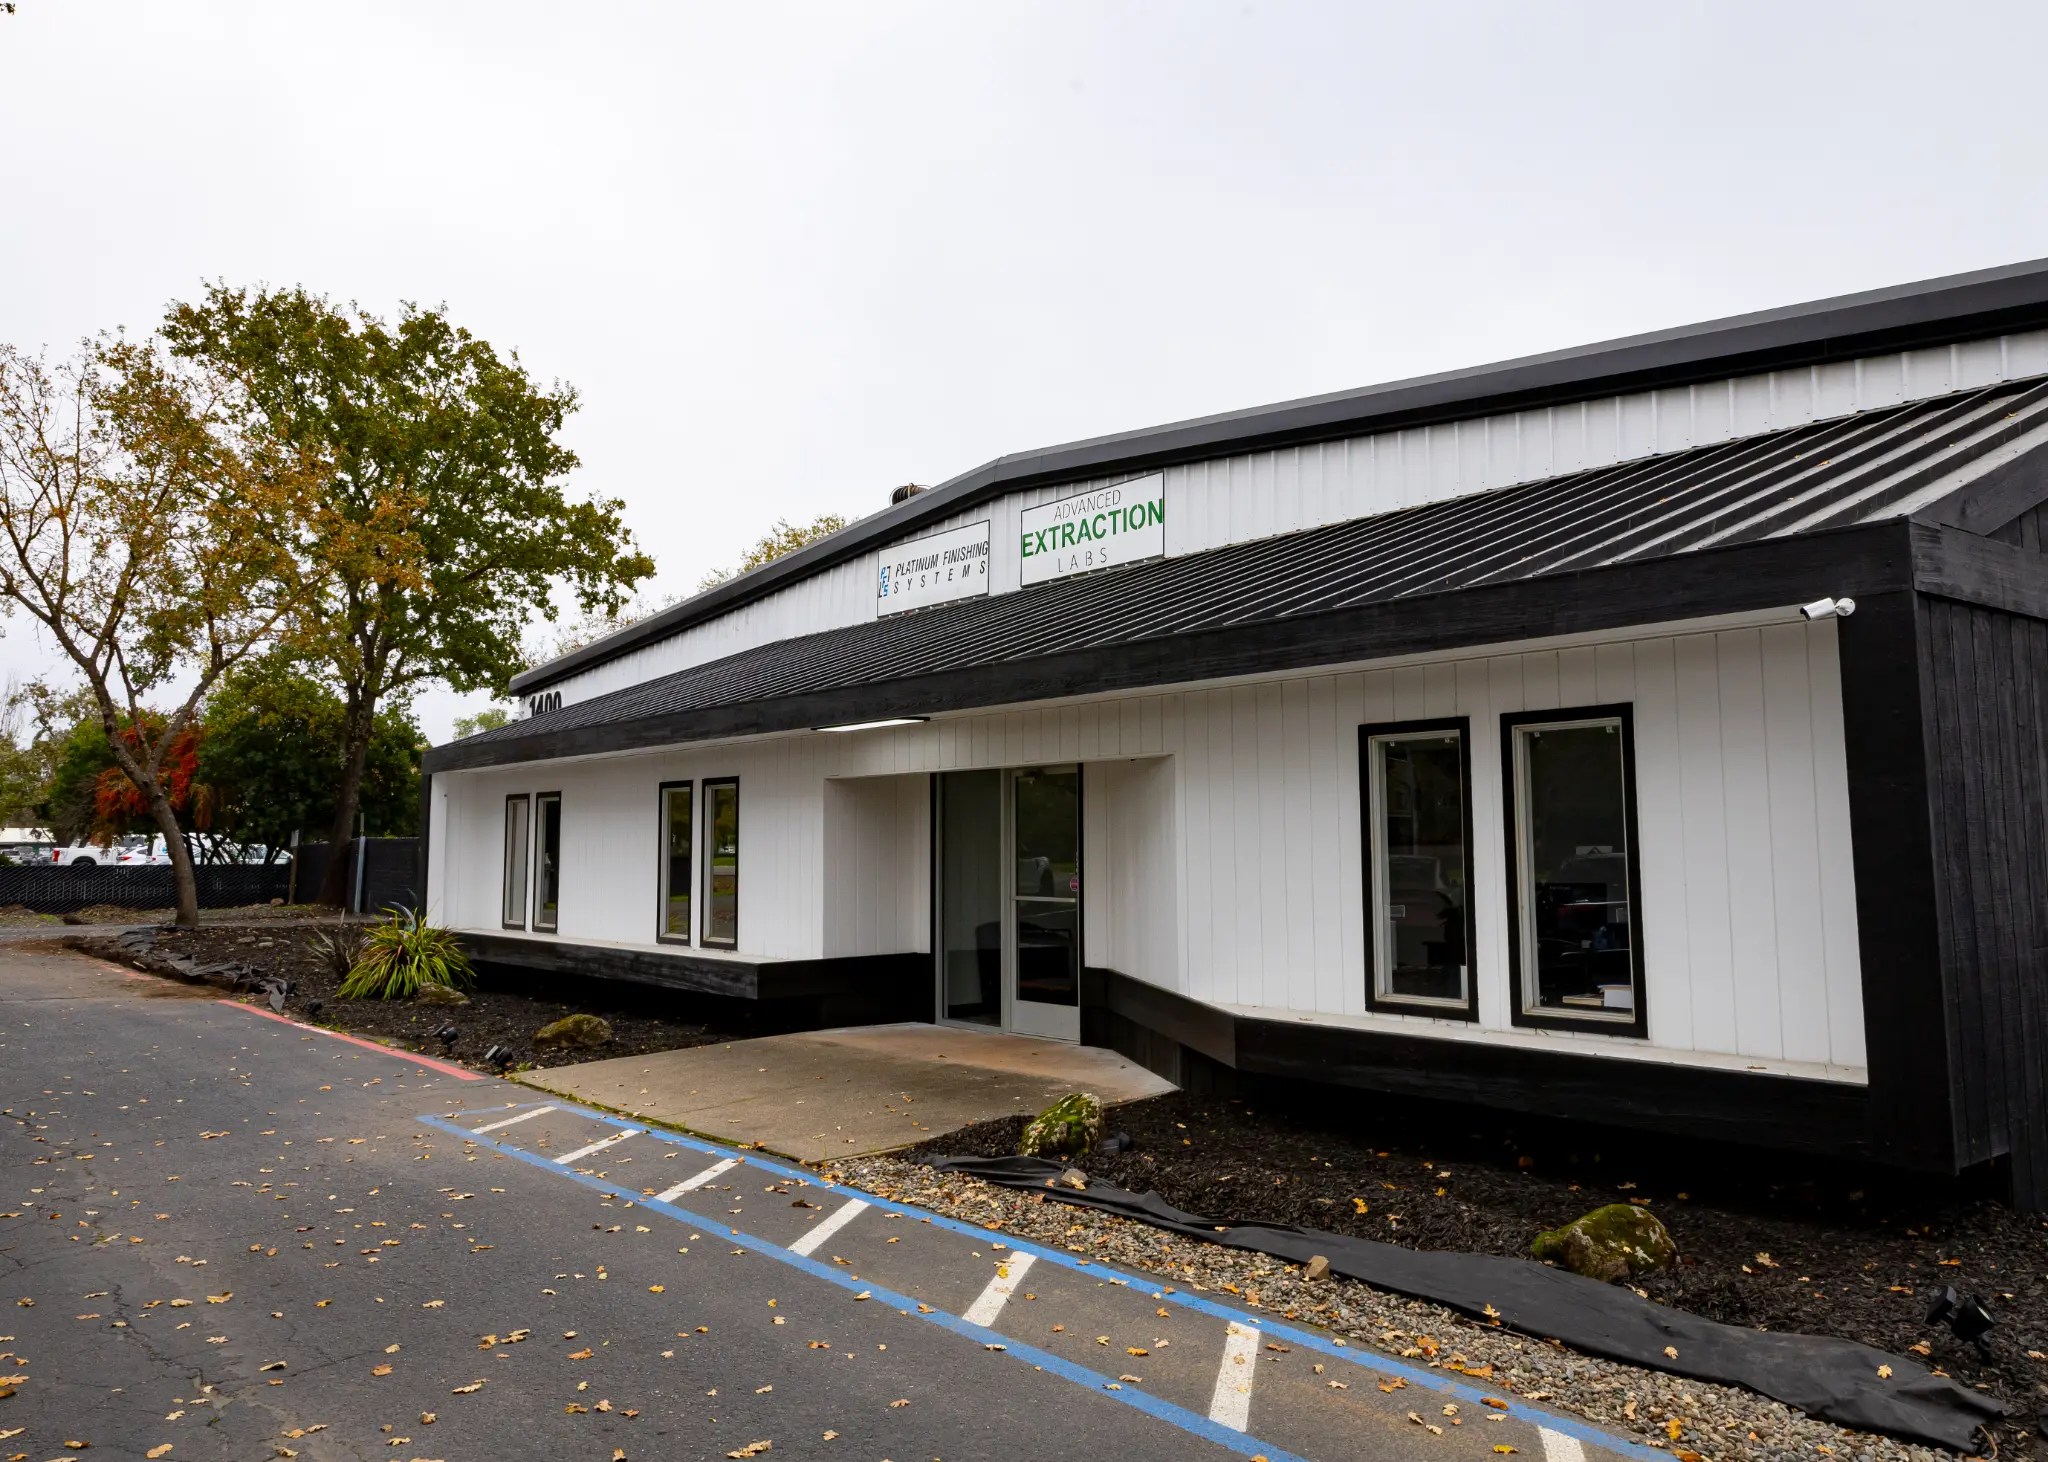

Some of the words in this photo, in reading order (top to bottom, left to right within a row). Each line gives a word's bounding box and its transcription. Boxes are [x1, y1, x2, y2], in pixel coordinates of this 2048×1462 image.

[1053, 489, 1121, 522] ADVANCED
[1022, 498, 1163, 558] EXTRACTION
[895, 553, 939, 578] PLATINUM
[943, 540, 989, 566] FINISHING
[1057, 547, 1108, 573] LABS
[893, 560, 986, 595] SYSTEMS
[529, 690, 562, 717] 1400
